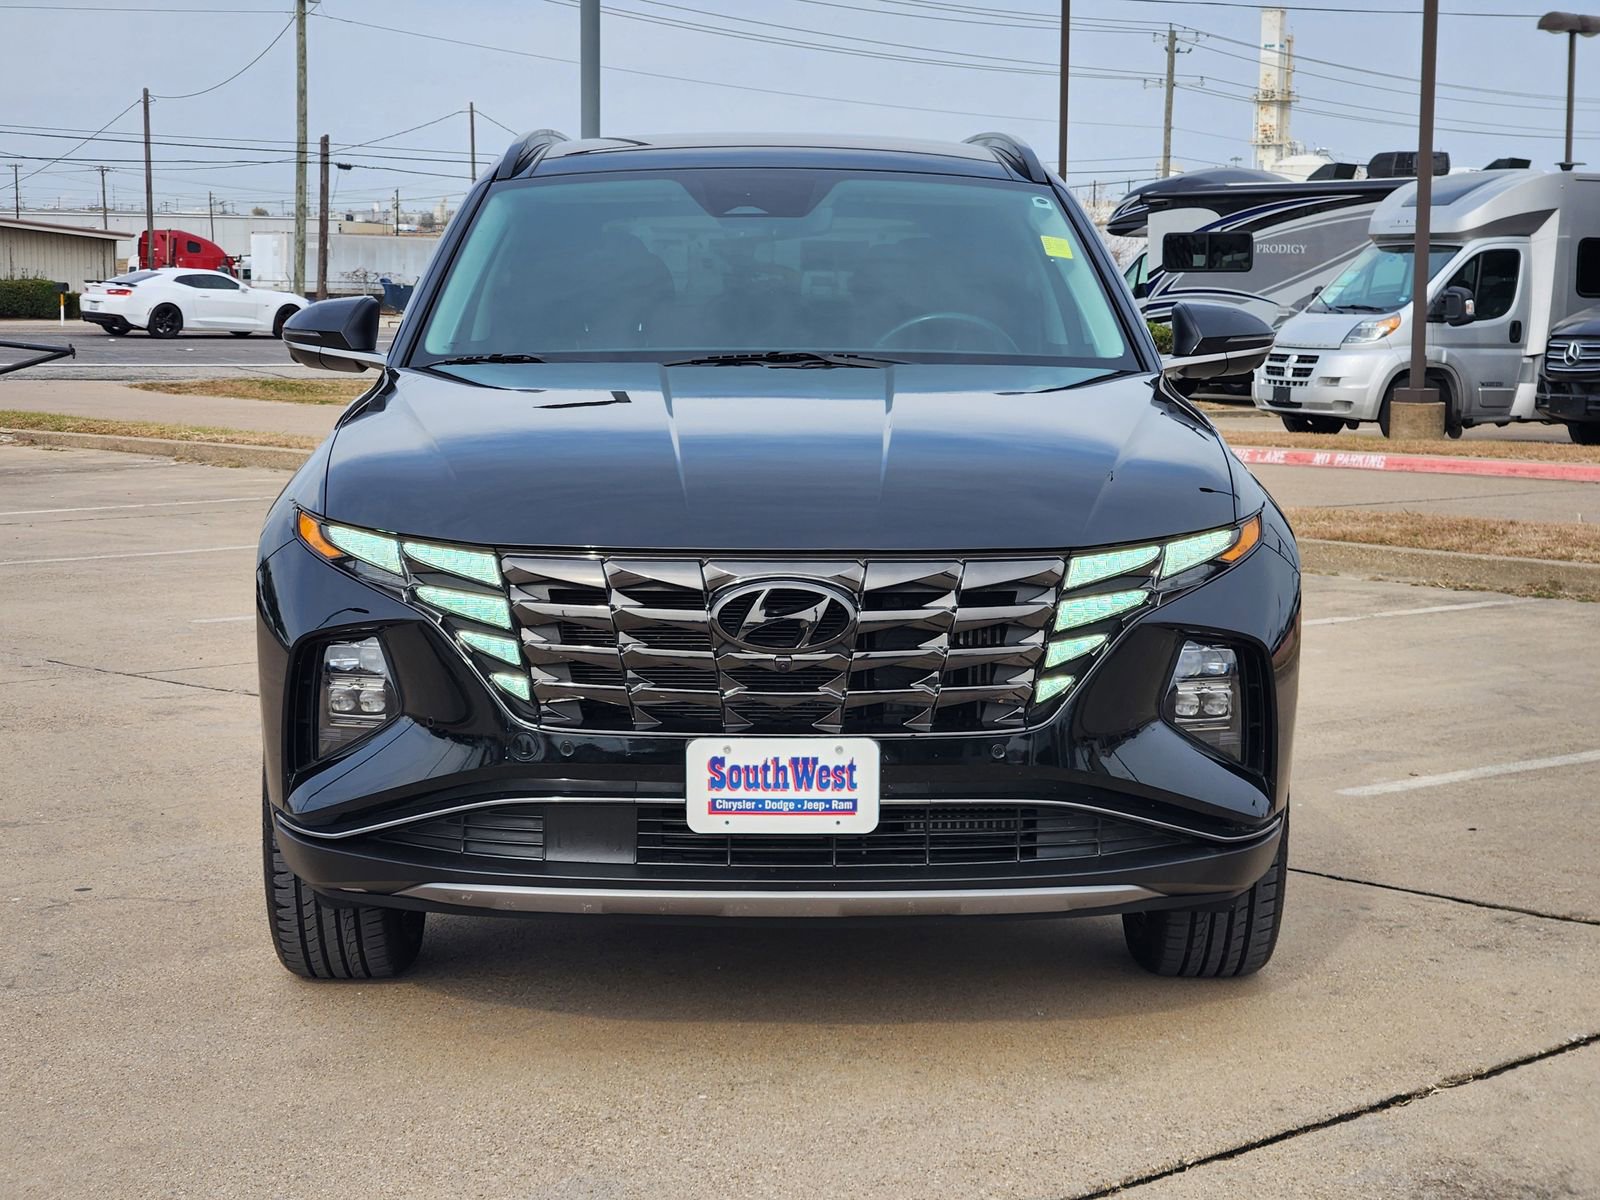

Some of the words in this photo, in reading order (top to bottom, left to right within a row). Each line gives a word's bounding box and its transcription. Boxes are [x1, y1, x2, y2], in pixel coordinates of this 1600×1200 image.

[1256, 244, 1307, 254] PRODIGY
[1256, 449, 1287, 463] LANE
[1334, 453, 1386, 469] PARKING
[708, 756, 857, 791] SouthWest
[716, 800, 755, 812] Chrysler
[765, 800, 795, 811] Dodge
[803, 800, 825, 811] Jeep
[832, 800, 853, 810] Ram
